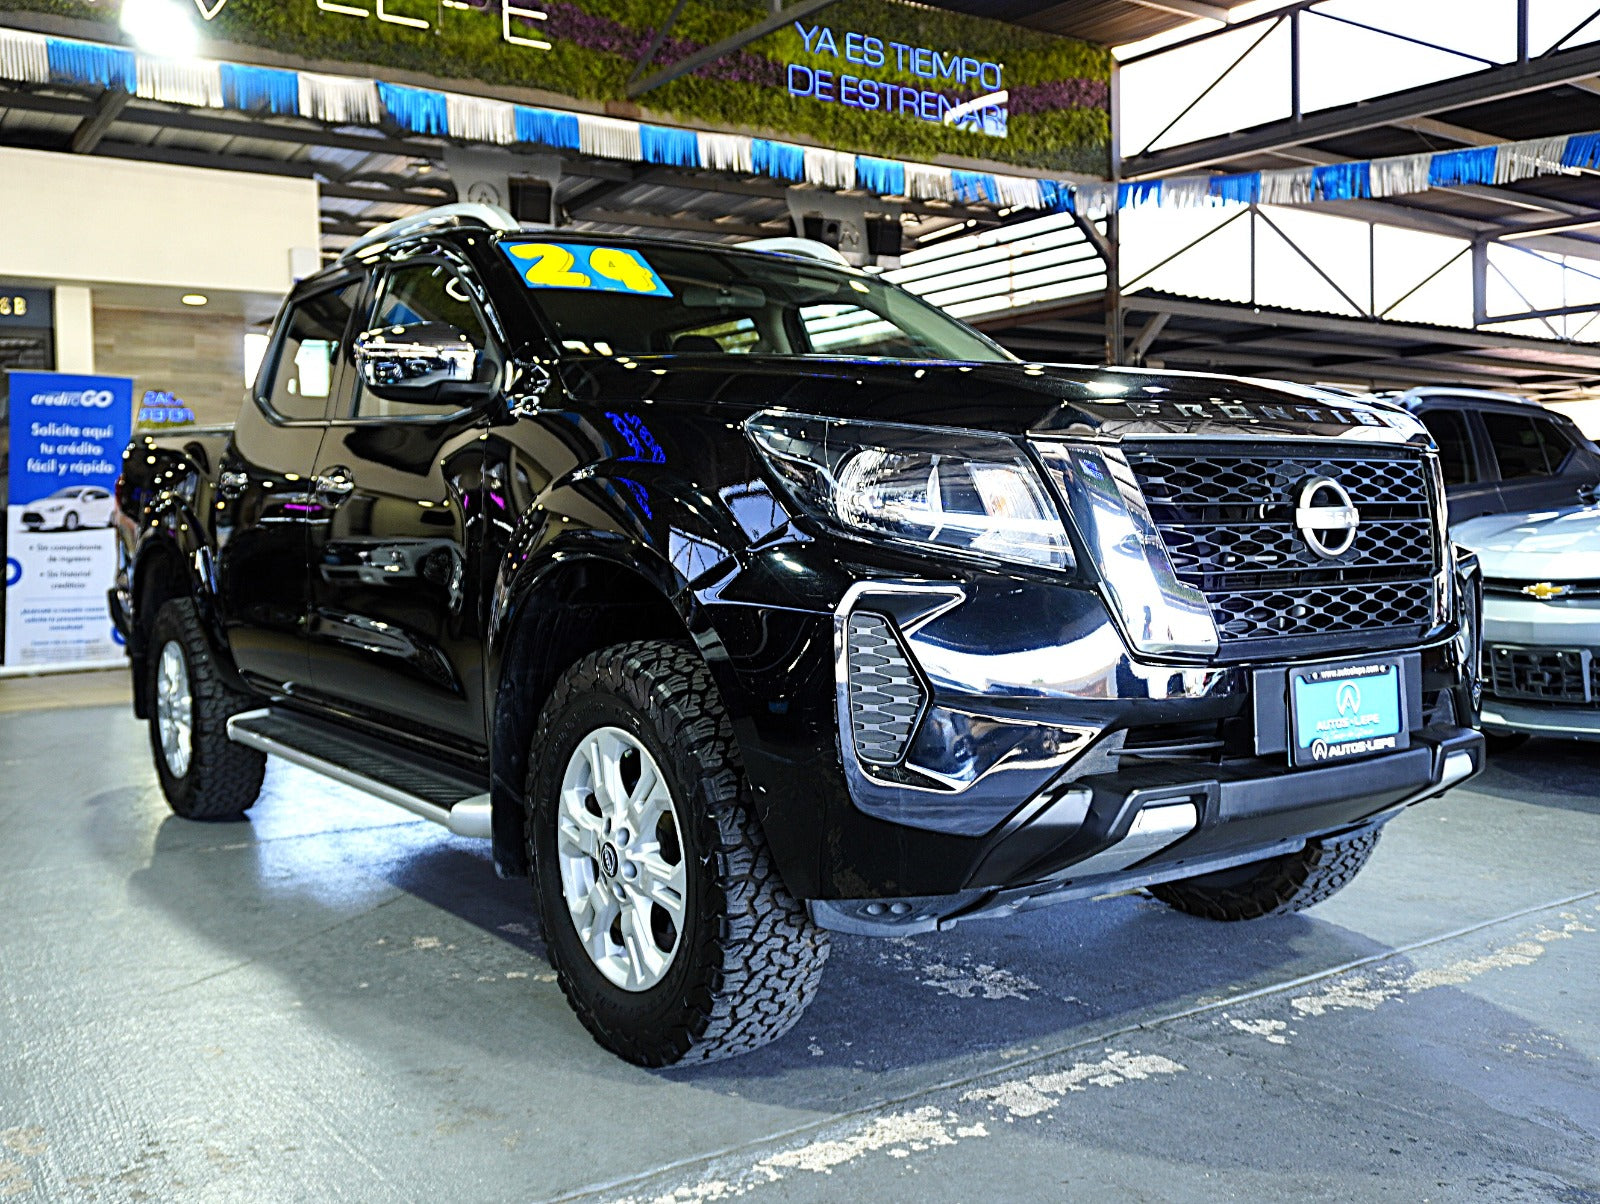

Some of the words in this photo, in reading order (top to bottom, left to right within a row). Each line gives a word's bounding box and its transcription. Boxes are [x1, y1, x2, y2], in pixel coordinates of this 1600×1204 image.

[795, 21, 839, 57] YA
[845, 32, 885, 68] ES
[889, 41, 1002, 92] TIEMPO
[787, 64, 835, 102] DE
[509, 243, 657, 292] 24
[31, 422, 81, 437] Solicita
[82, 424, 114, 441] aquí
[40, 442, 56, 455] tu
[56, 441, 104, 456] crédito
[27, 457, 57, 472] fácil
[58, 463, 68, 476] y
[70, 459, 116, 476] rápido
